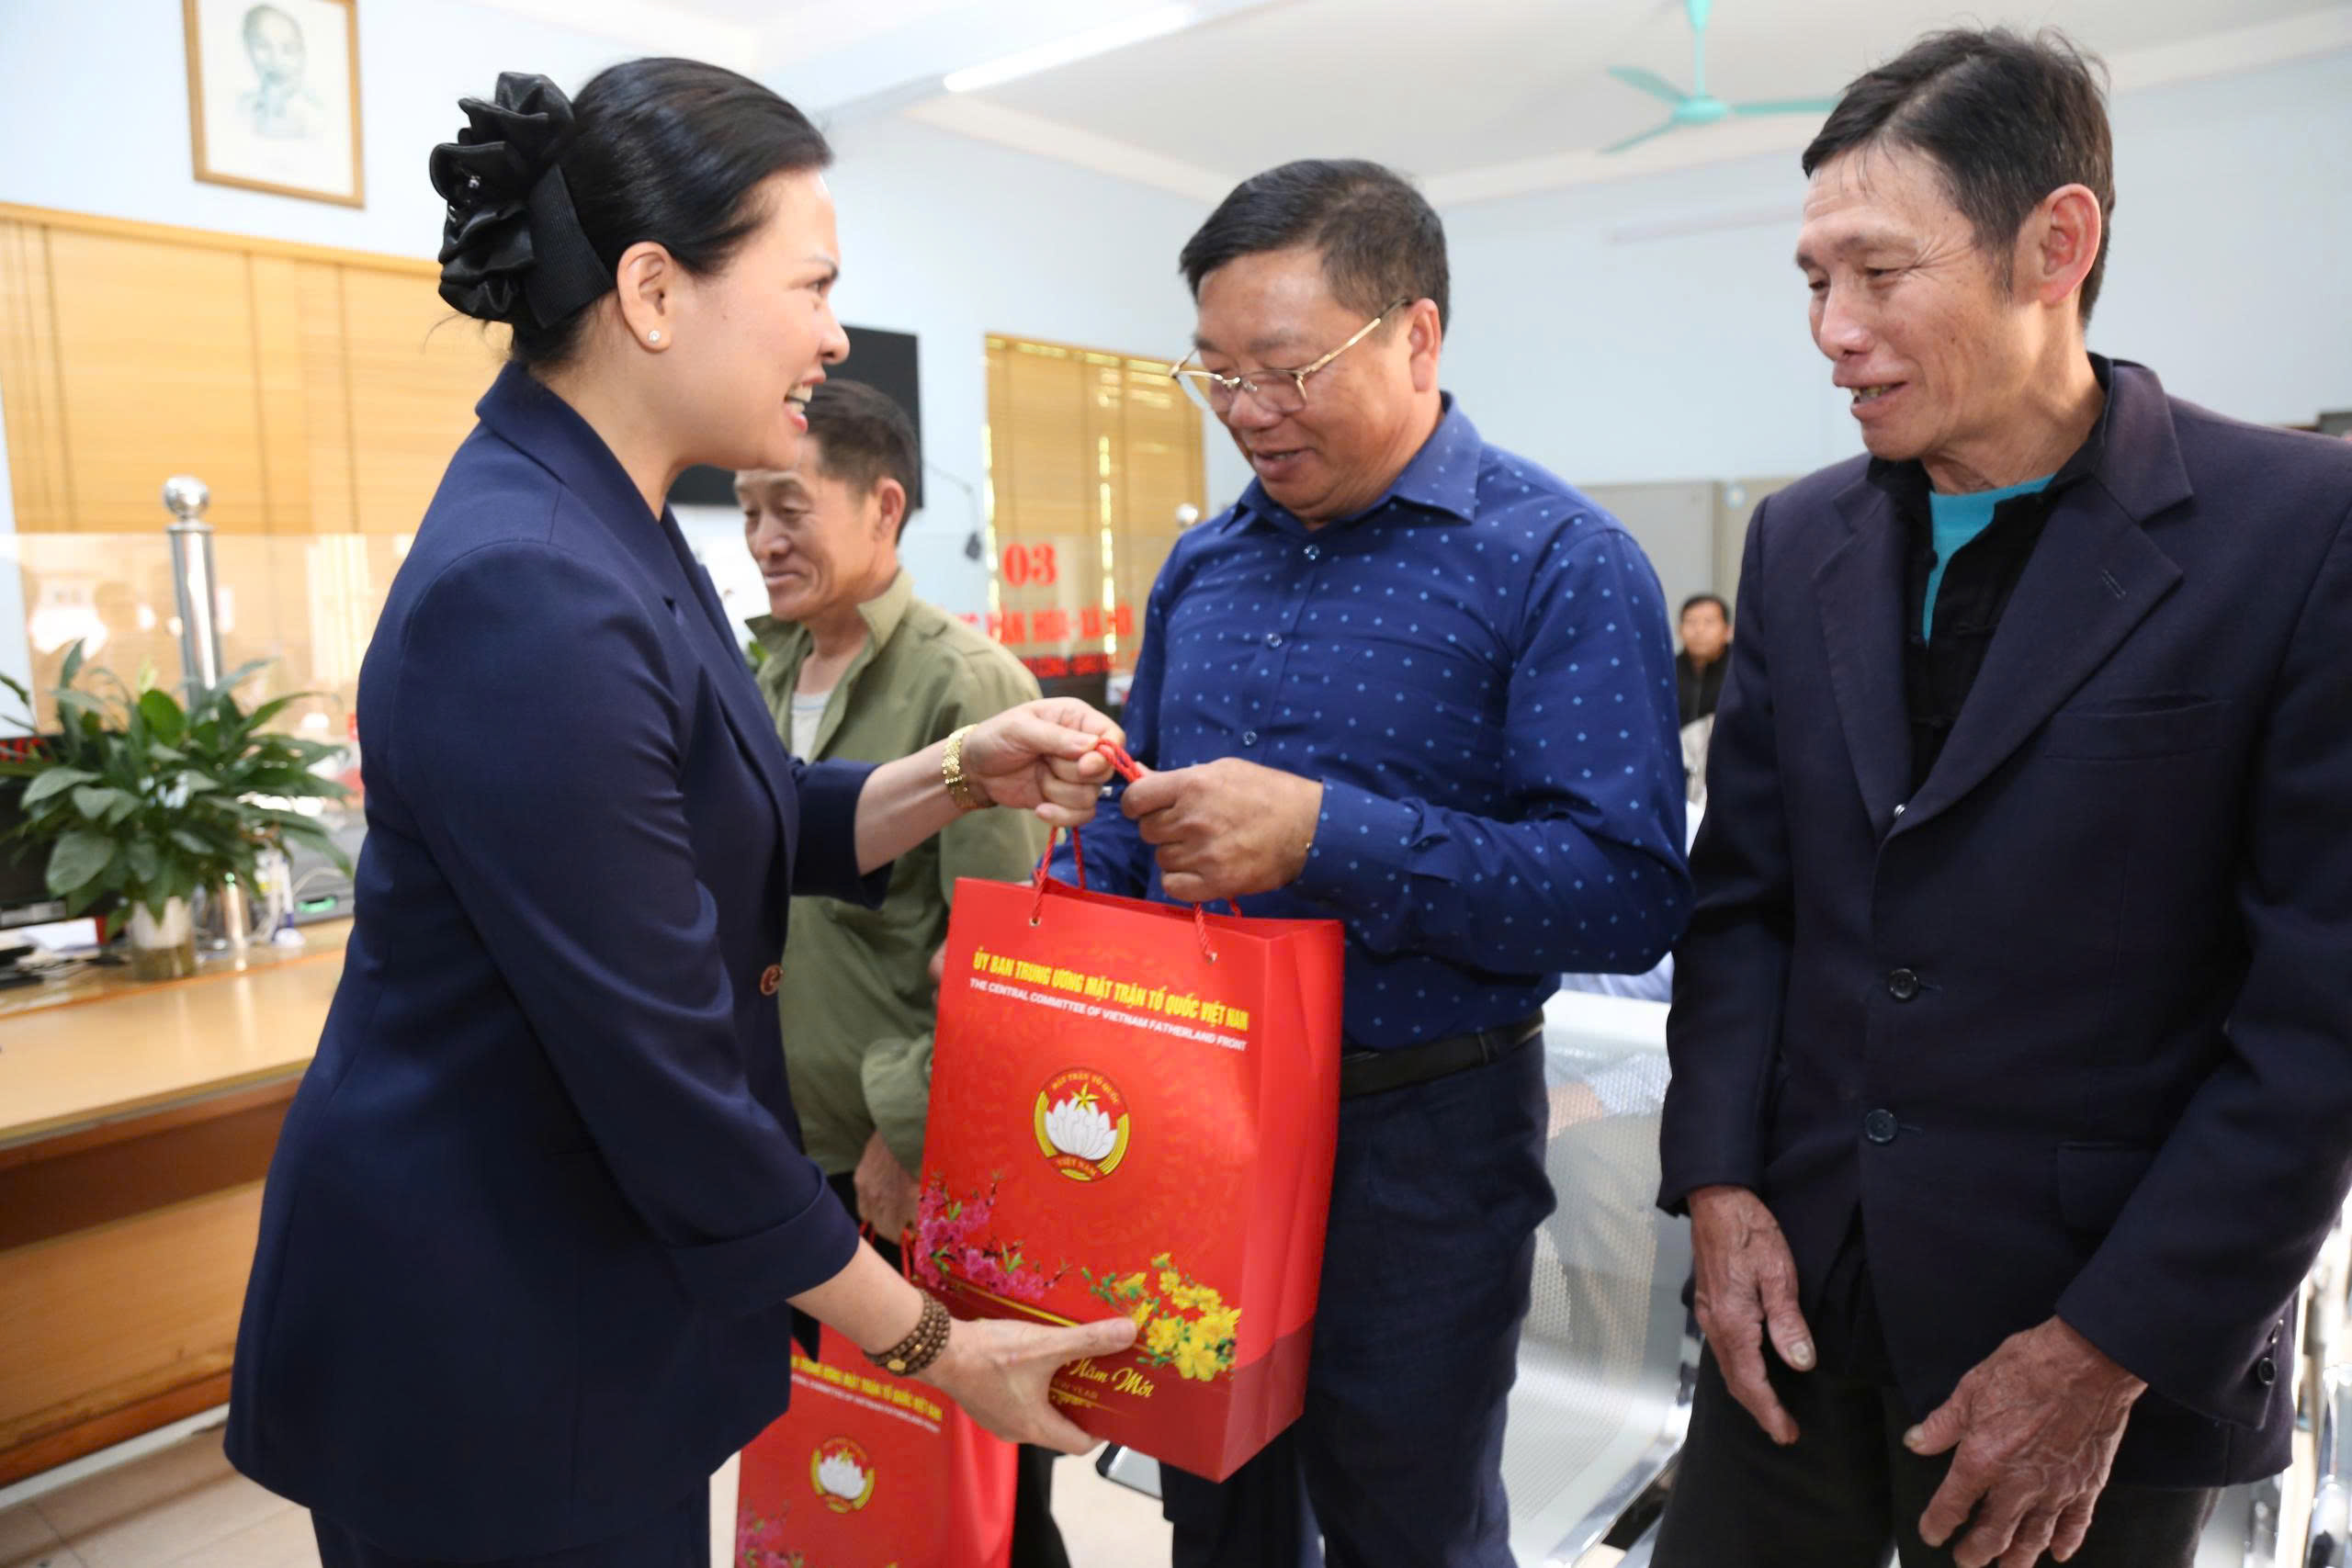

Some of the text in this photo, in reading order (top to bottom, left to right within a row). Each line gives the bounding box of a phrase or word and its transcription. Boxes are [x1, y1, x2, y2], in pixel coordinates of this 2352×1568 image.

[1002, 543, 1057, 588] 03
[970, 977, 1248, 1052] THE CENTRAL COMMITTEE OF VIETNAM FATHERLAND FRONT
[973, 945, 990, 971] ỦY
[989, 955, 1015, 977] BAN
[1014, 960, 1052, 986] TRUNG
[1051, 967, 1084, 993] ƯƠNG
[1114, 982, 1148, 1009] TRẬN
[1165, 993, 1200, 1019] QUỐC
[1200, 1000, 1227, 1028] VIỆT
[1226, 1008, 1250, 1032] NAM
[1111, 1367, 1156, 1398] Mới
